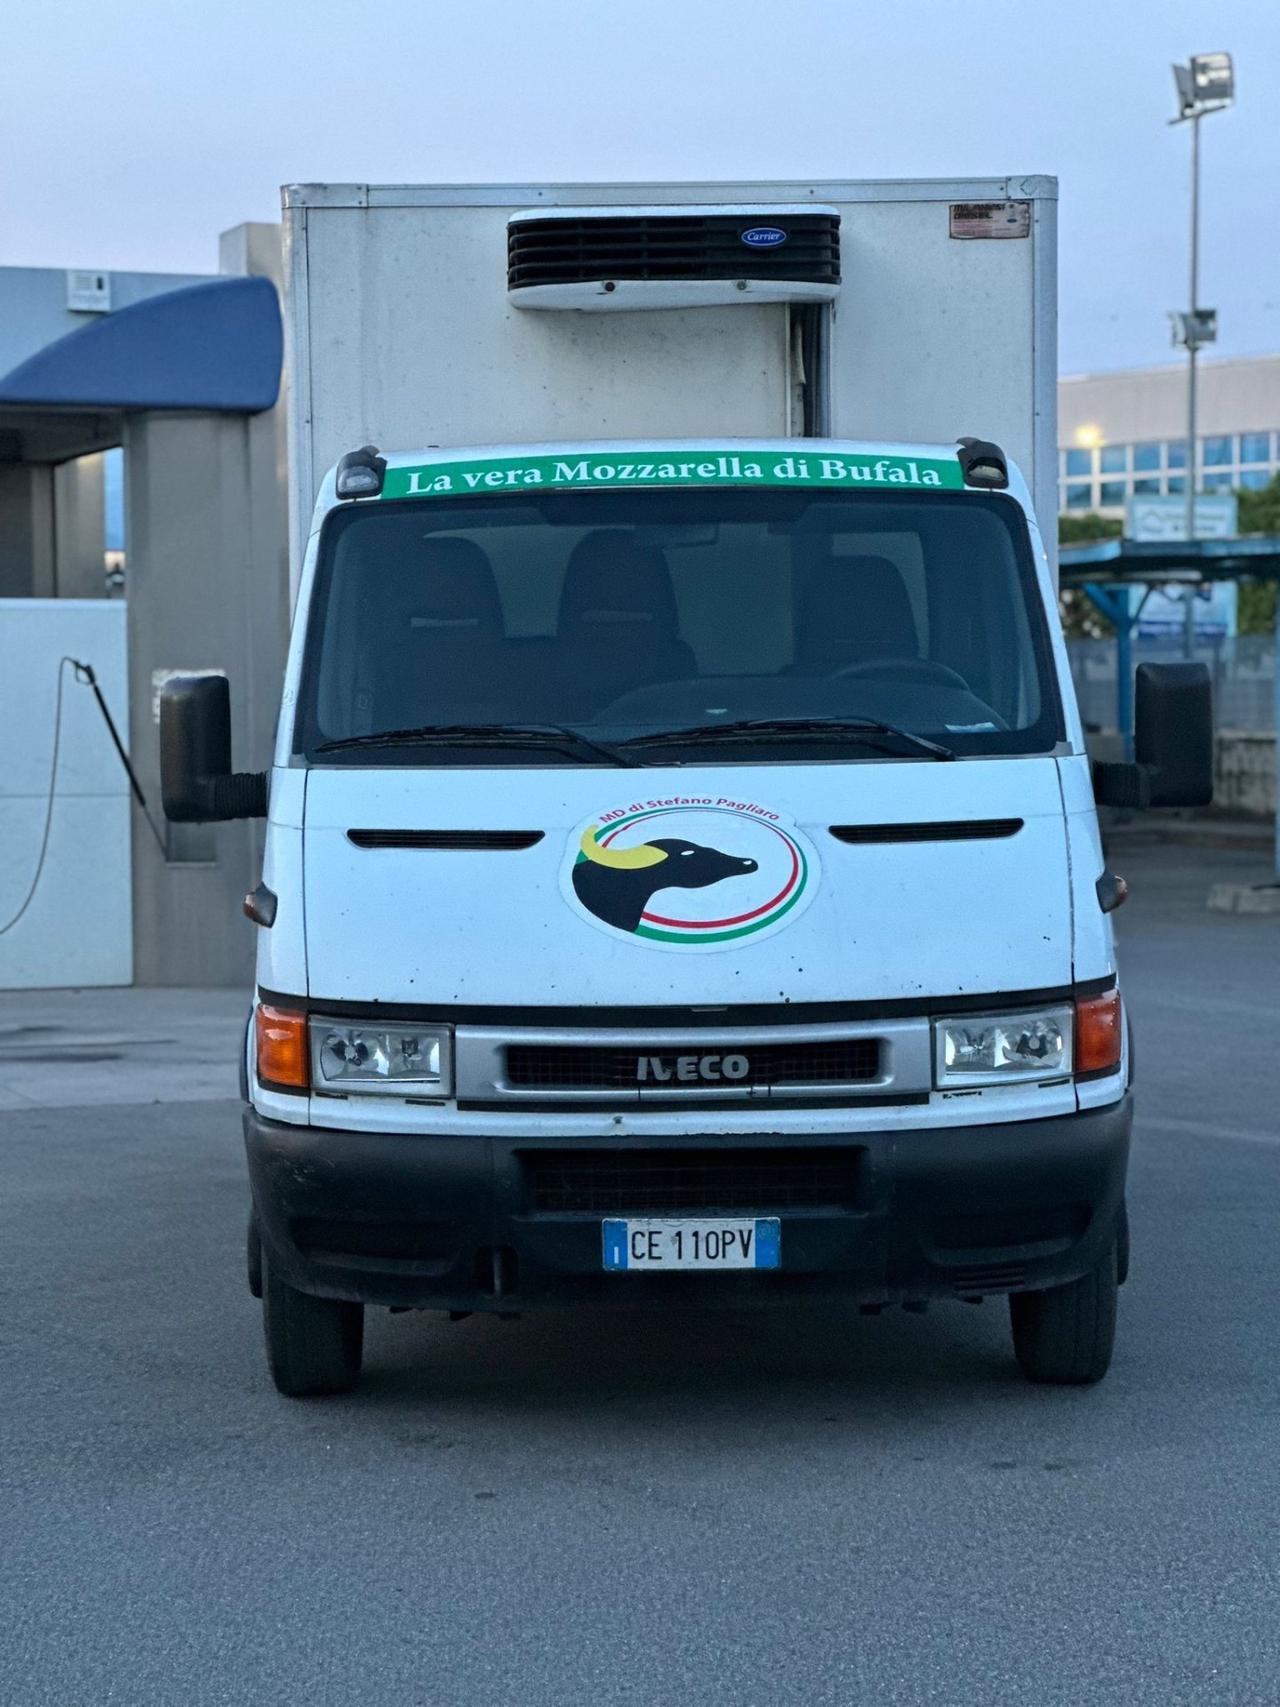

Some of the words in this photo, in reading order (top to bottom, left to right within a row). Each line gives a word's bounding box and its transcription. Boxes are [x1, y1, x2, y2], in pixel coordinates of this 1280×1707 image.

[747, 231, 781, 241] Carrier
[406, 471, 453, 494] La
[461, 468, 543, 488] vera
[551, 457, 764, 482] Mozzarella
[773, 457, 811, 479] di
[818, 459, 942, 486] Bufala
[599, 809, 626, 824] MD
[629, 802, 645, 813] di
[646, 796, 712, 809] Stefano
[716, 797, 780, 821] Pagliaro
[631, 1230, 662, 1260] CE
